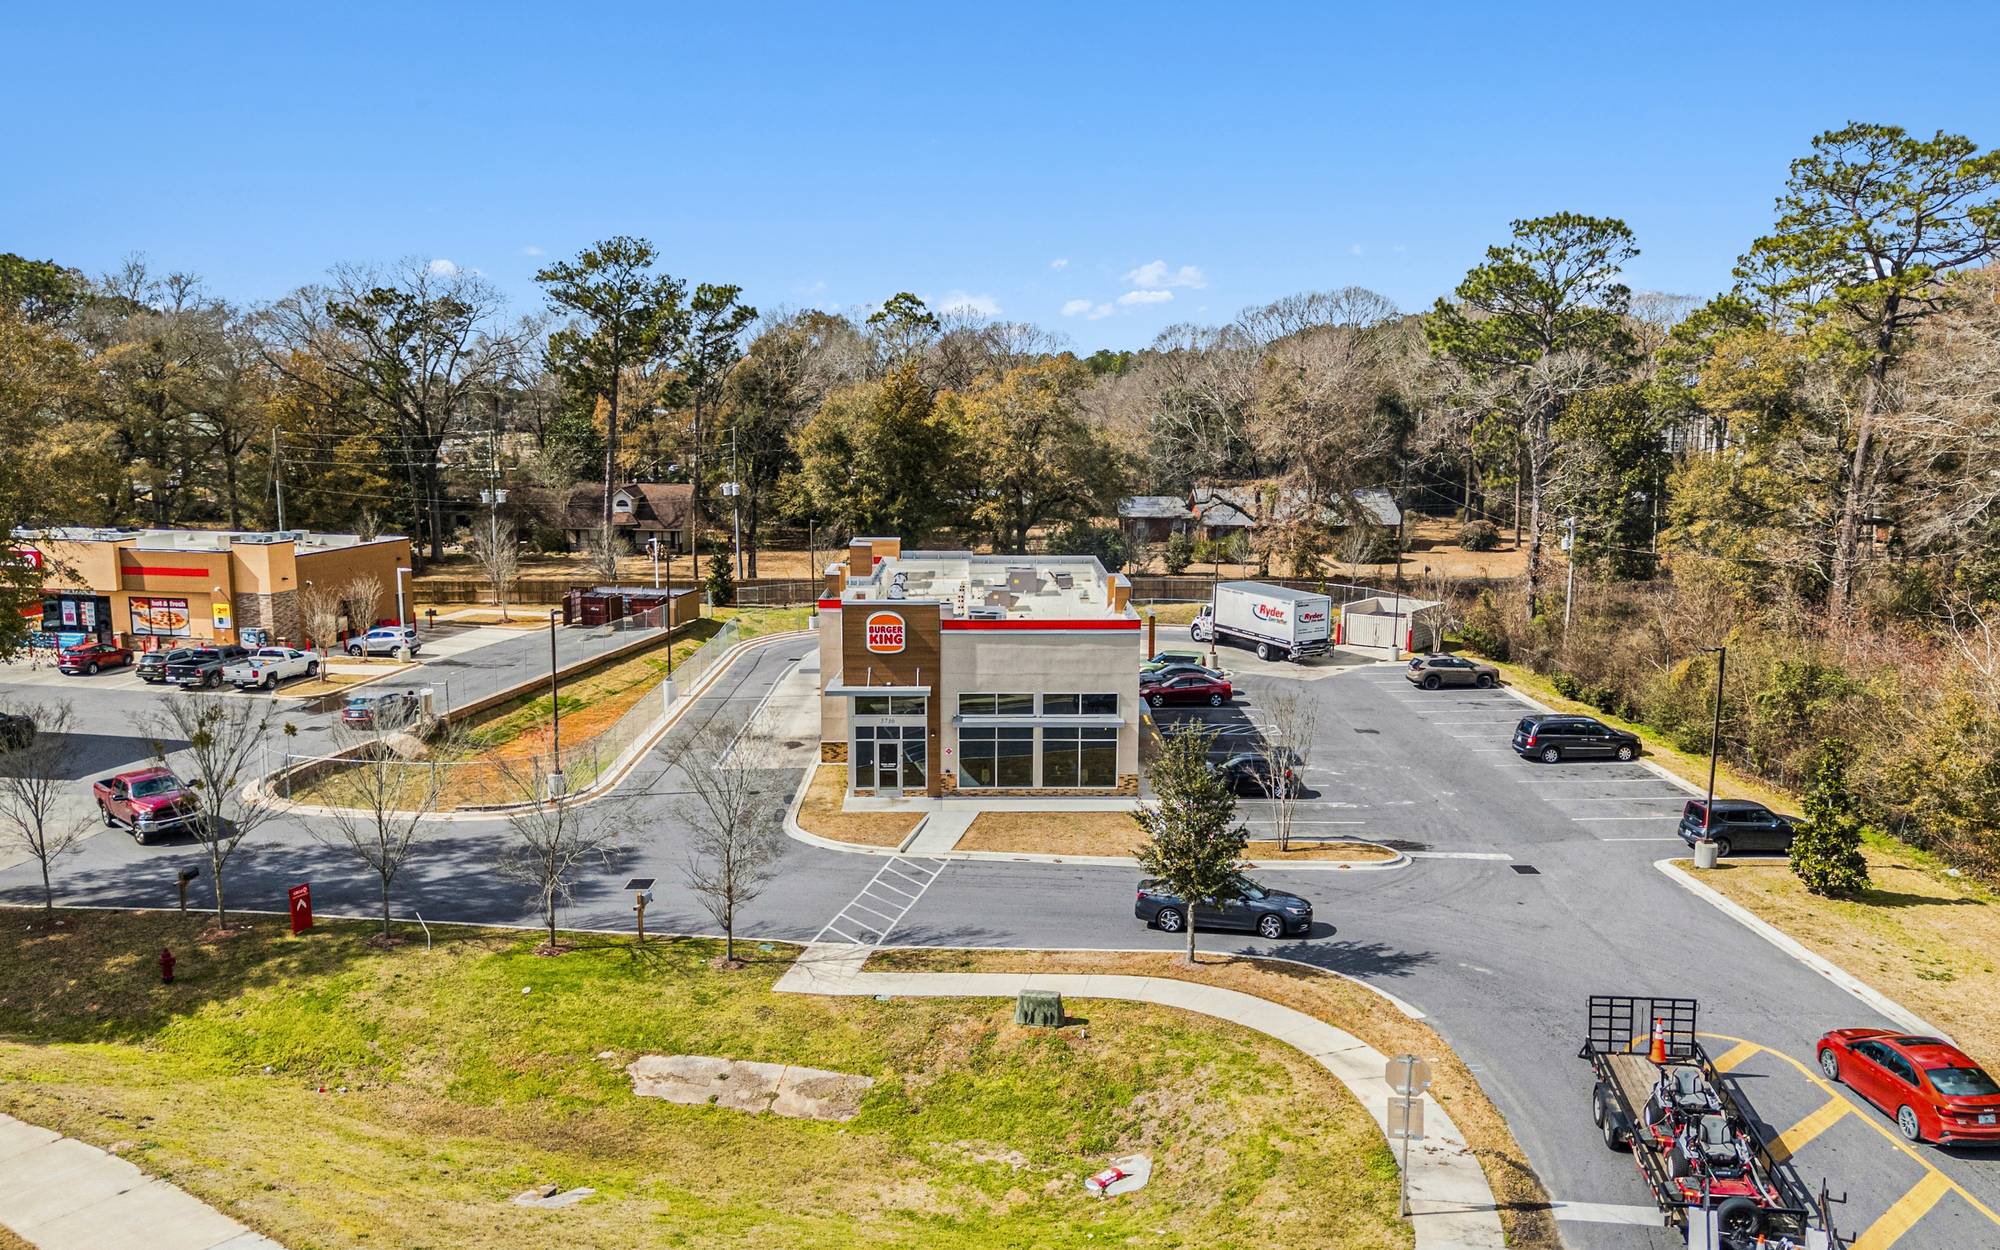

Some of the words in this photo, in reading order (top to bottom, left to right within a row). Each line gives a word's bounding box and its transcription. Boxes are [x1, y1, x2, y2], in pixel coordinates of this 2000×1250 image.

[1259, 604, 1284, 618] Ryder
[1304, 612, 1323, 621] Ryder
[869, 634, 903, 644] KING
